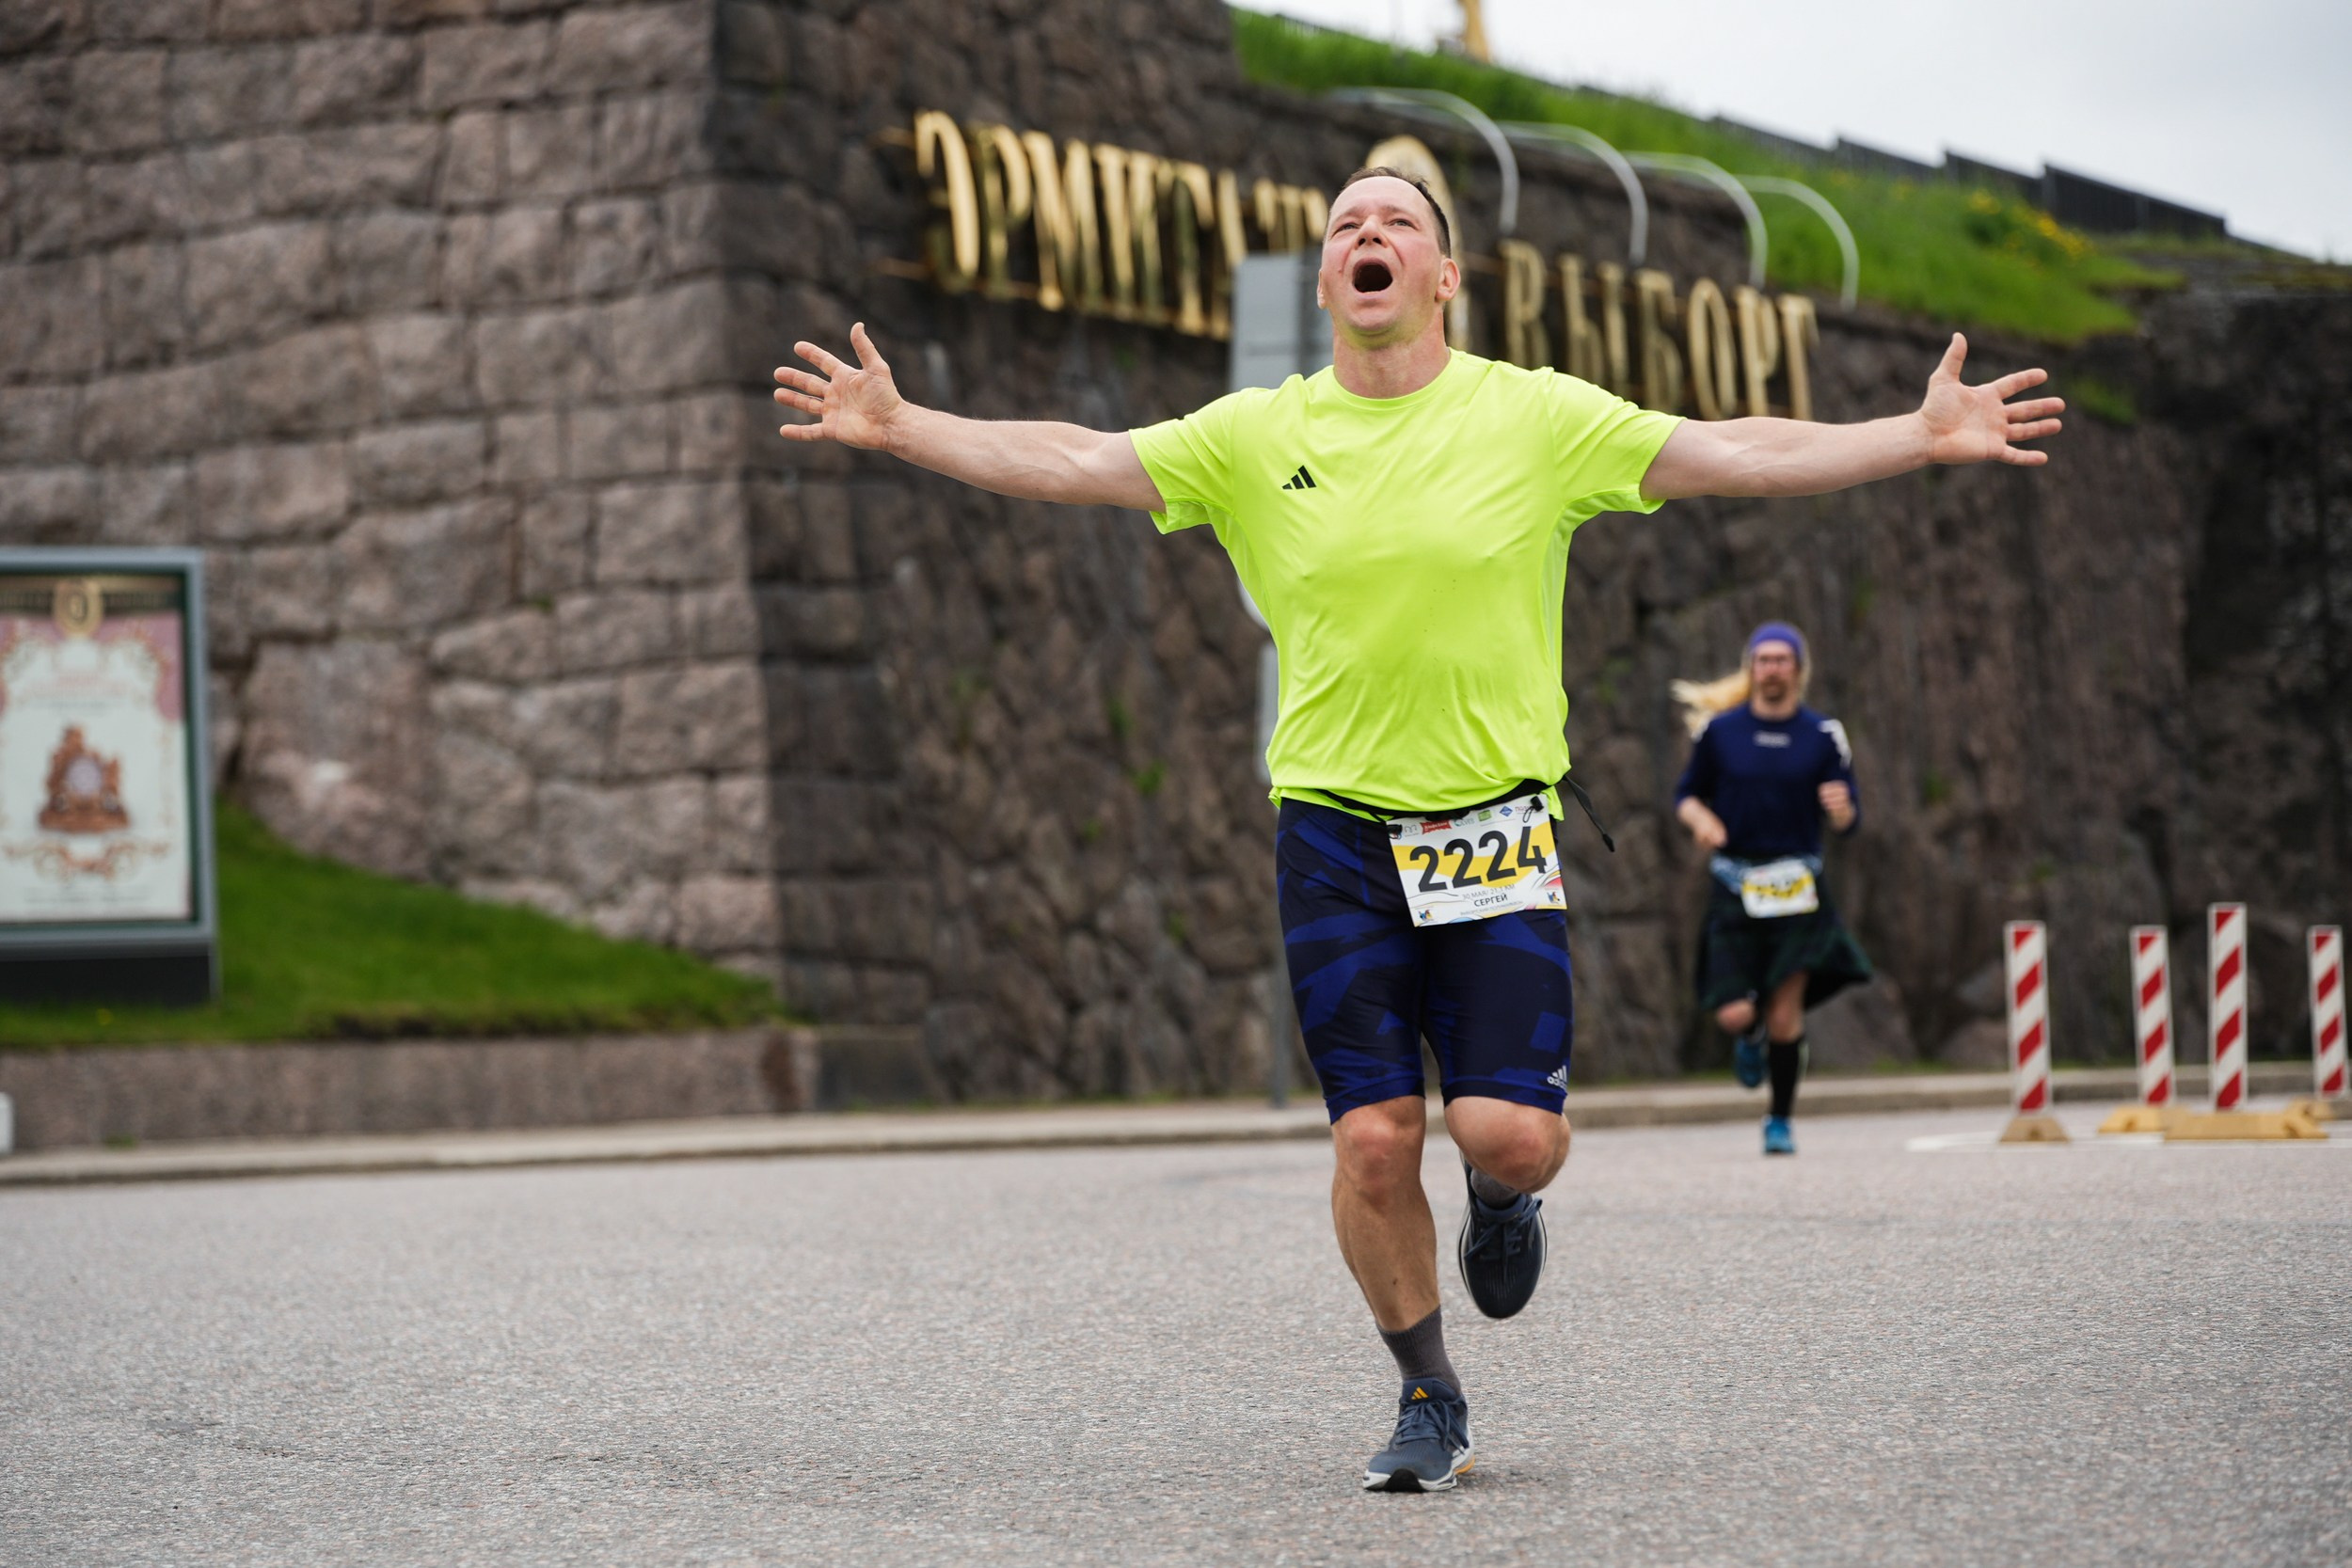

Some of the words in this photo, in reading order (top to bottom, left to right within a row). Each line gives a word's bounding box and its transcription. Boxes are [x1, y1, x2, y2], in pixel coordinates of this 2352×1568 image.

[1499, 239, 1820, 422] ВЫБОРГ
[1409, 826, 1547, 893] 2224
[1473, 892, 1508, 907] СЕРГЕЙ
